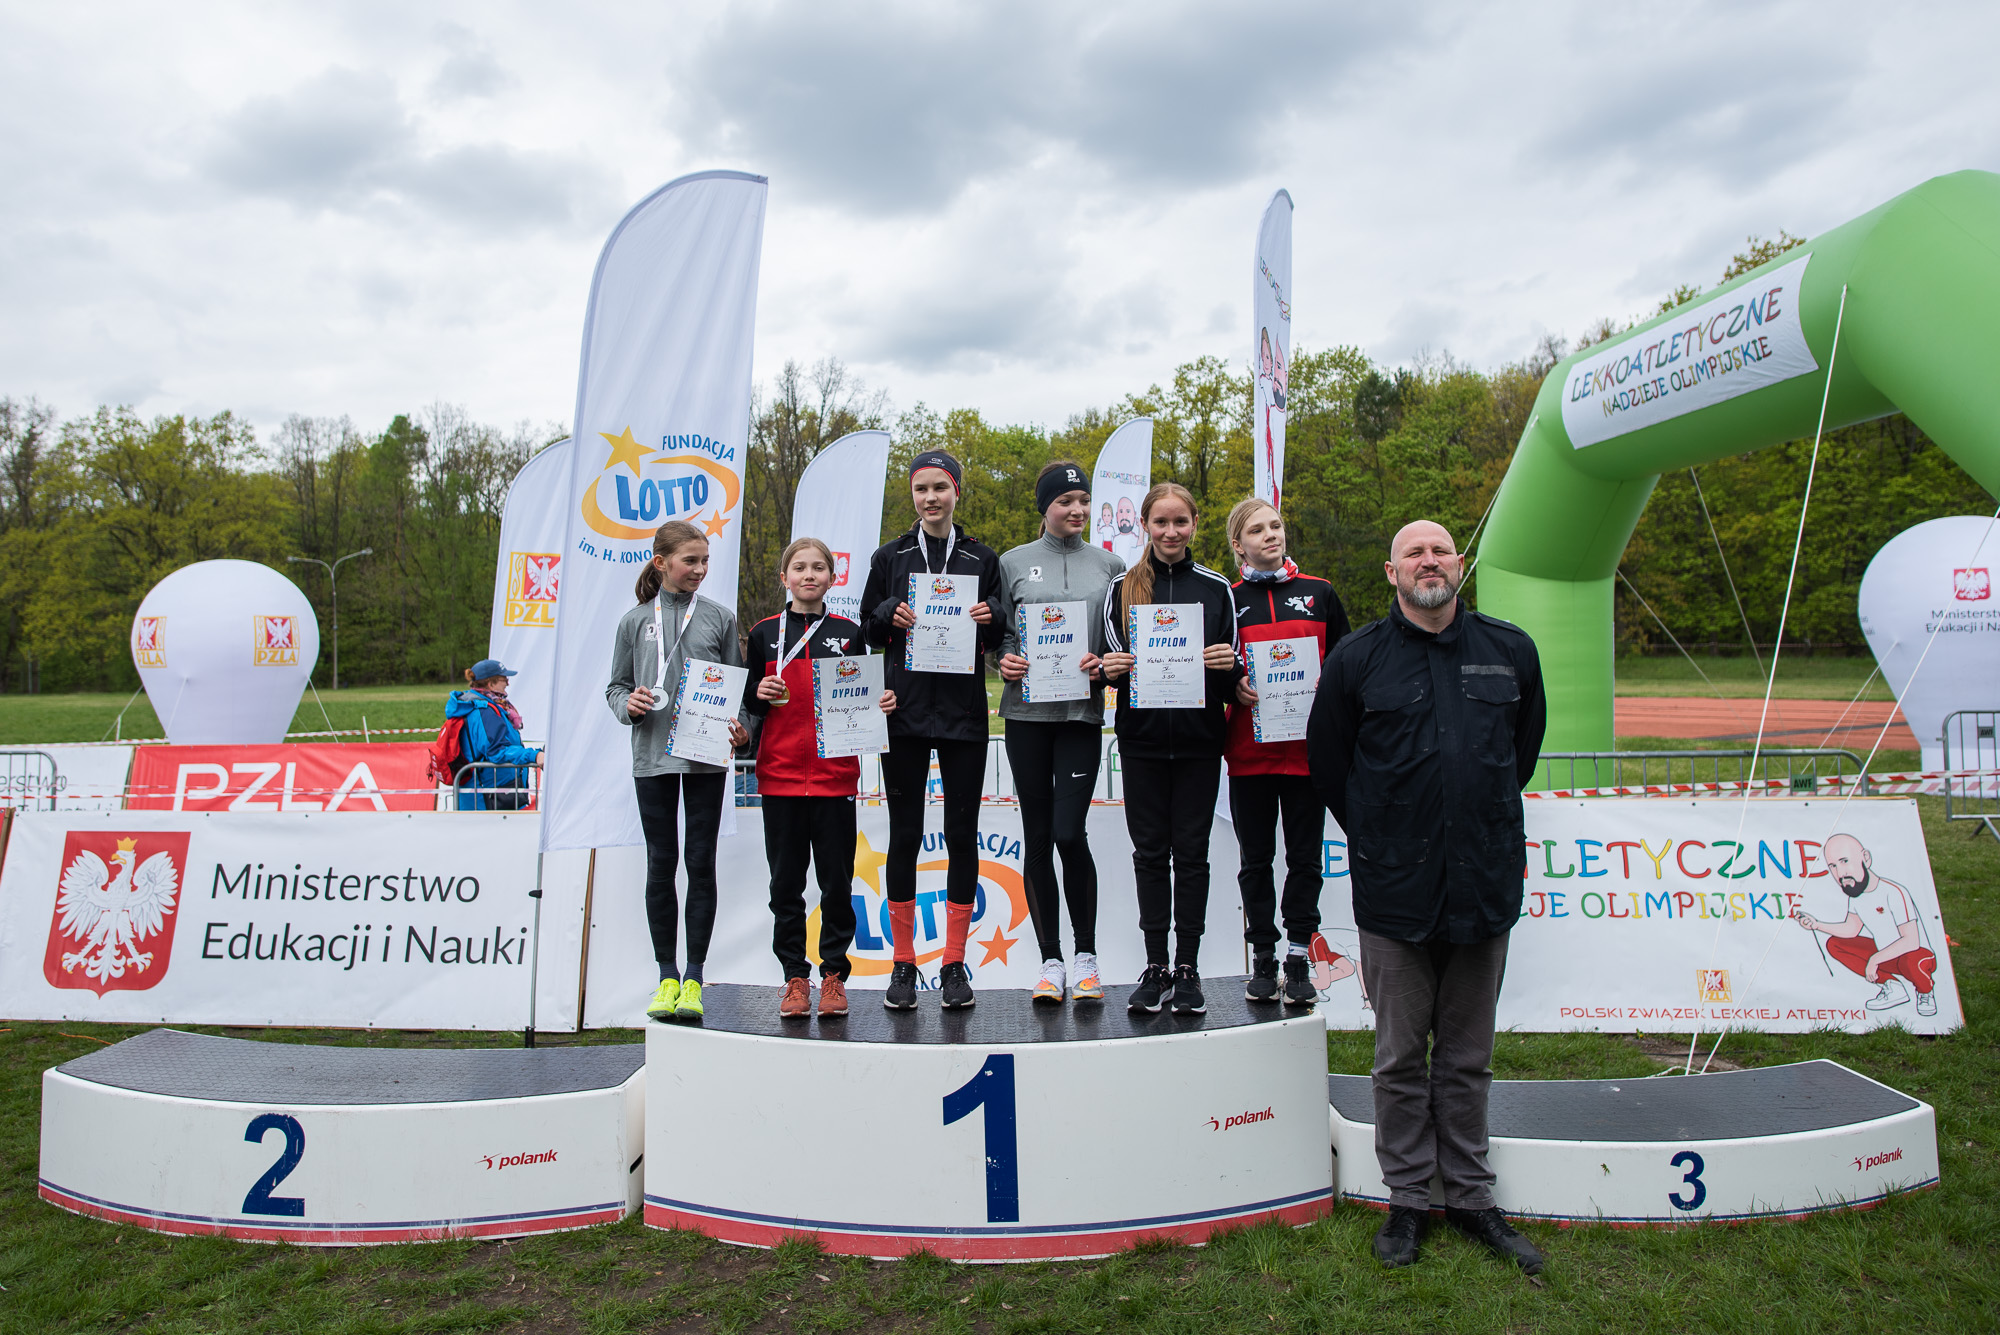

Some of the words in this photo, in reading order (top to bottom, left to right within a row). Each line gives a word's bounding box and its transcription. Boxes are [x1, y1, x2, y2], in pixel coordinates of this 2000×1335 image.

[1571, 286, 1783, 403] LEKKOATLETYCZNE
[1602, 376, 1669, 418] NADZIEJE
[1670, 336, 1772, 392] OLIMPIJSKIE
[662, 434, 735, 462] FUNDACJA
[615, 473, 708, 522] LOTTO
[578, 536, 598, 558] im.
[602, 547, 617, 561] H.
[619, 548, 654, 564] KONO
[508, 602, 556, 624] PZL
[925, 605, 962, 616] DYPLOM
[1037, 633, 1074, 645] DYPLOM
[1925, 622, 1977, 634] Edukacji
[1148, 637, 1187, 647] DYPLOM
[256, 650, 297, 664] PZLA
[1267, 670, 1305, 683] DYPLOM
[692, 692, 727, 707] DYPLOM
[831, 686, 869, 699] DYPLOM
[0, 773, 67, 794] erstwo
[173, 761, 389, 813] PZLA
[1793, 779, 1812, 790] AWF
[211, 863, 480, 903] Ministerstwo
[1581, 890, 1804, 921] OLIMPIJSKIE
[201, 922, 371, 971] Edukacji
[381, 924, 393, 964] i
[404, 923, 529, 967] Nauki
[1560, 1007, 1623, 1019] POLSKI
[1628, 1008, 1705, 1022] ZWIĄZEK
[1711, 1008, 1780, 1020] LEKKIEJ
[1786, 1008, 1867, 1021] ATLETYKI
[1224, 1106, 1275, 1131] polanik
[942, 1053, 1020, 1223] 1
[241, 1113, 306, 1217] 2
[498, 1149, 558, 1170] polanik
[1865, 1147, 1903, 1171] polanik
[1668, 1150, 1707, 1211] 3
